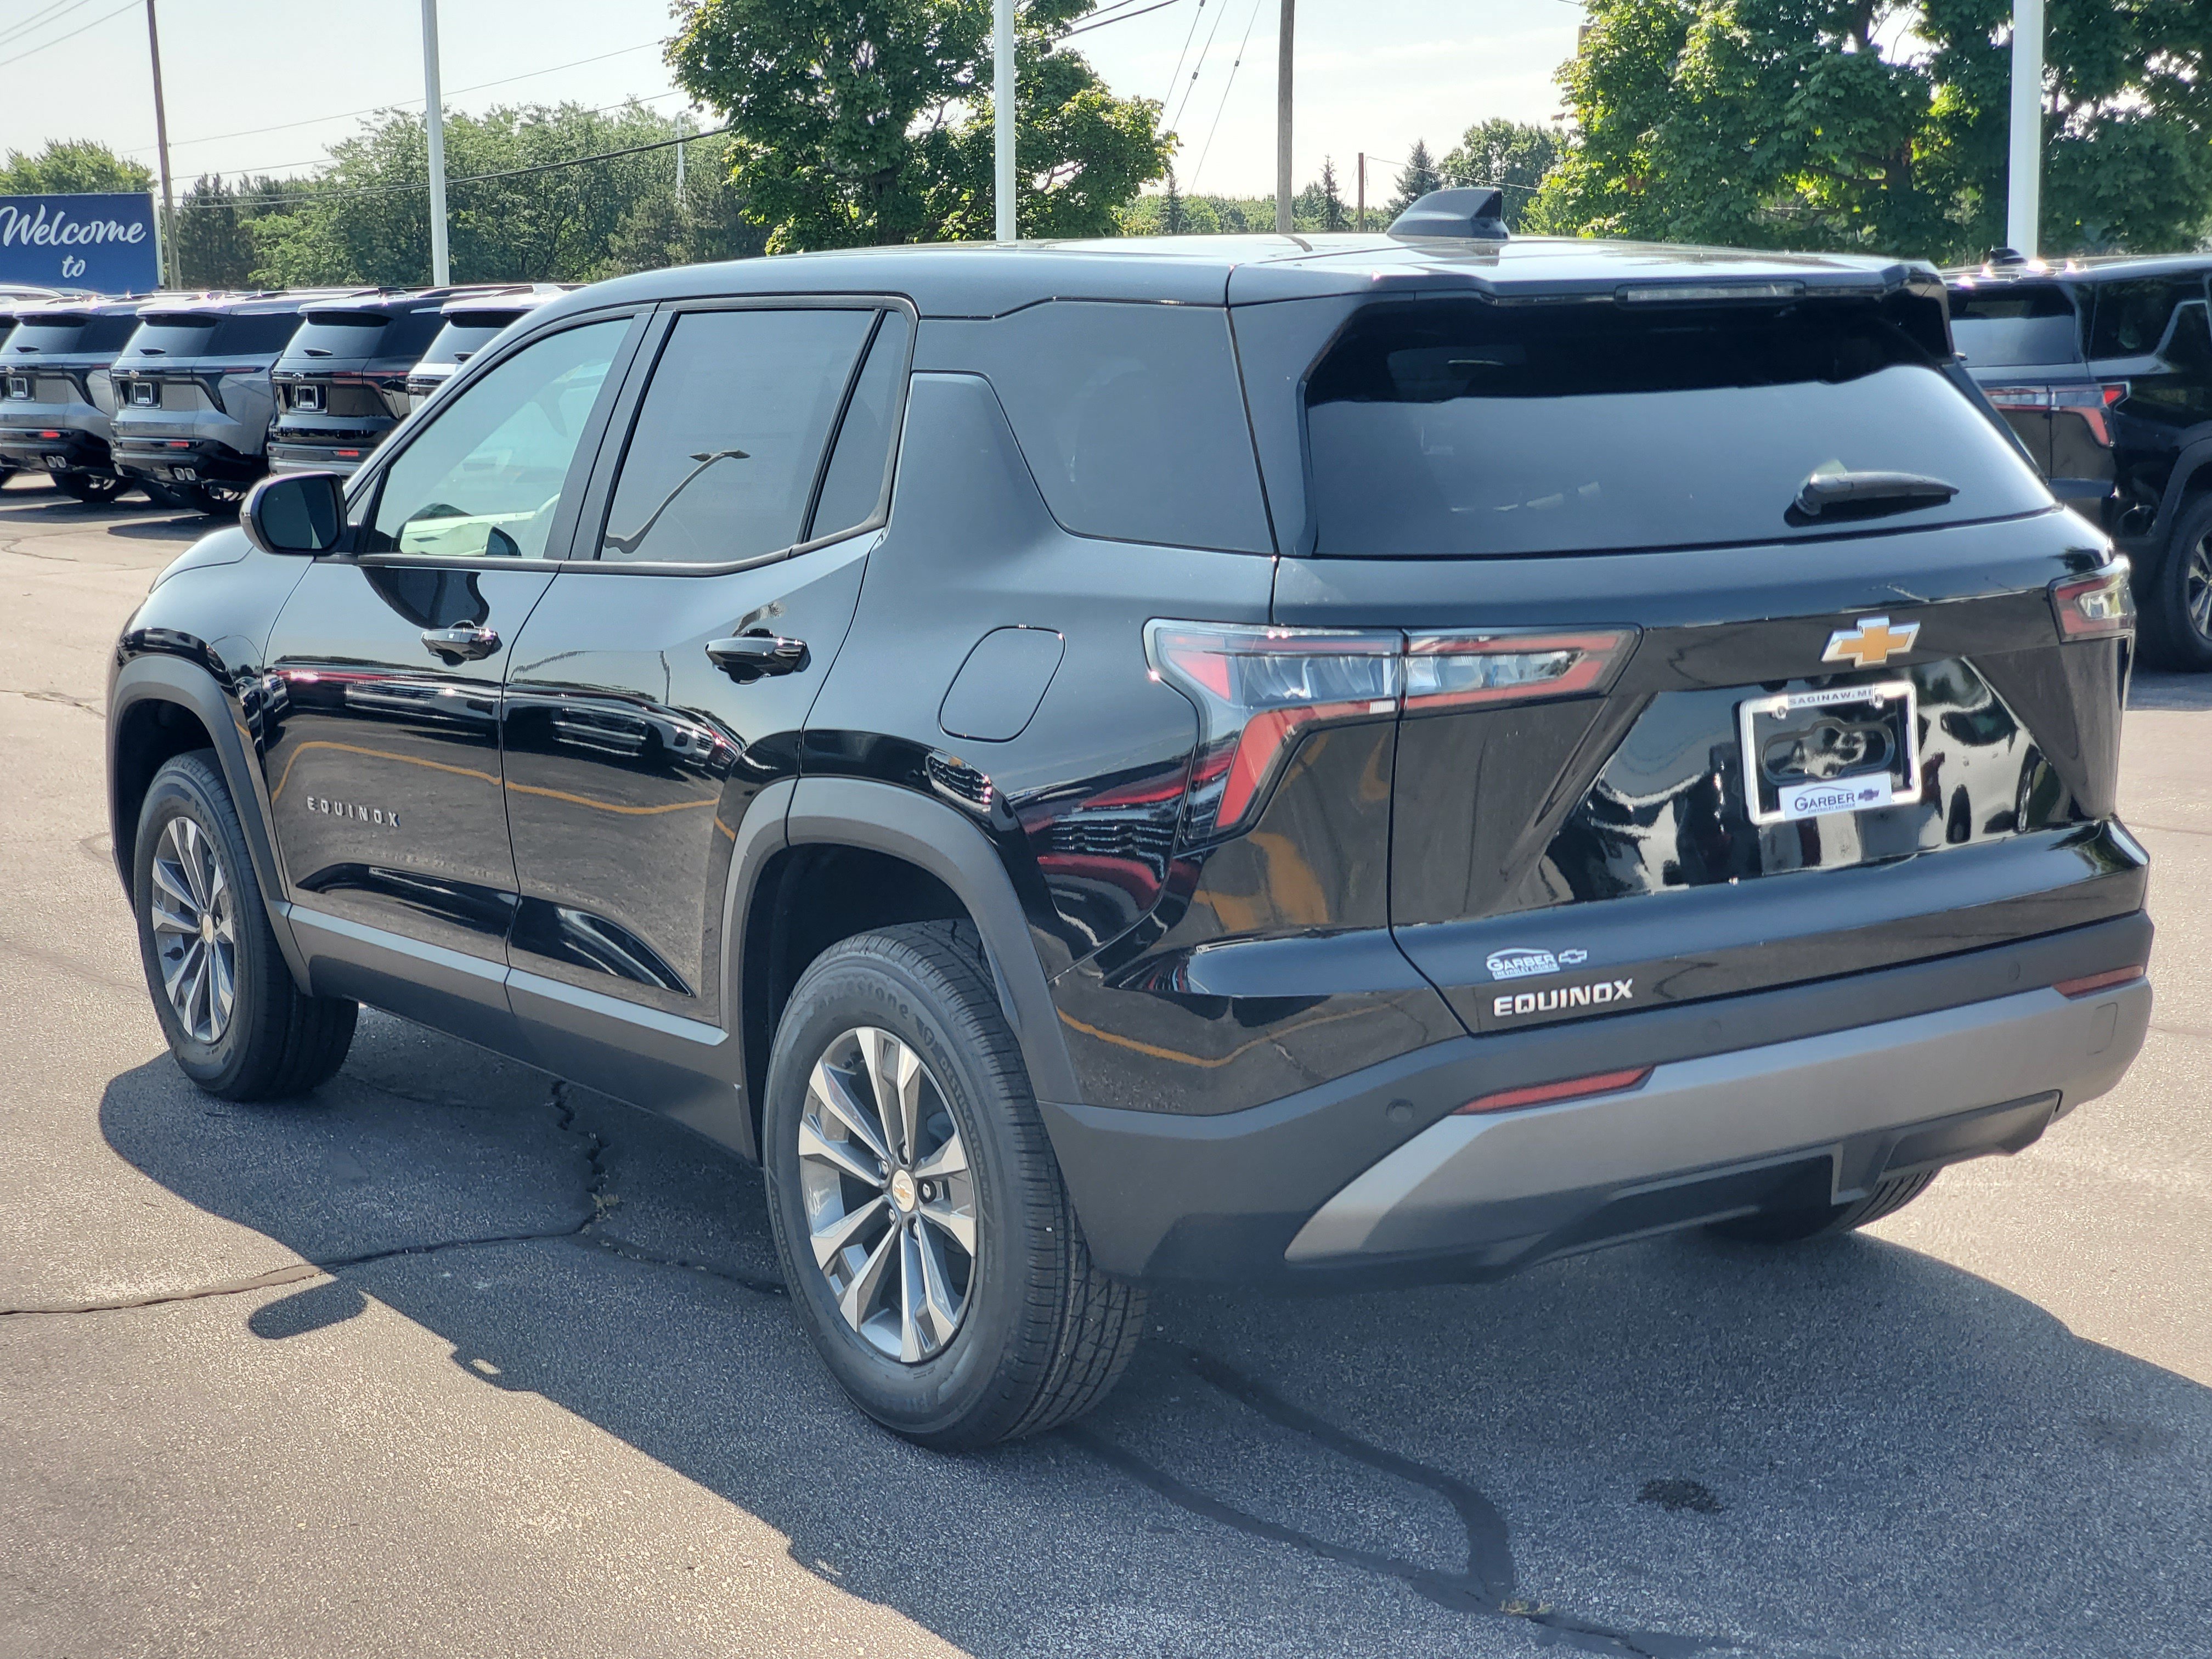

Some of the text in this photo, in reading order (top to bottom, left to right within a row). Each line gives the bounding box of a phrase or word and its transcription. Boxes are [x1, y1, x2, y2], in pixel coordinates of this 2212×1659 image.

[0, 204, 146, 247] Welcome
[62, 255, 86, 278] to
[307, 795, 399, 827] EQUINOX
[1795, 793, 1855, 811] GARBER
[1486, 954, 1556, 972] GARBER
[1493, 978, 1633, 1017] EQUINOX
